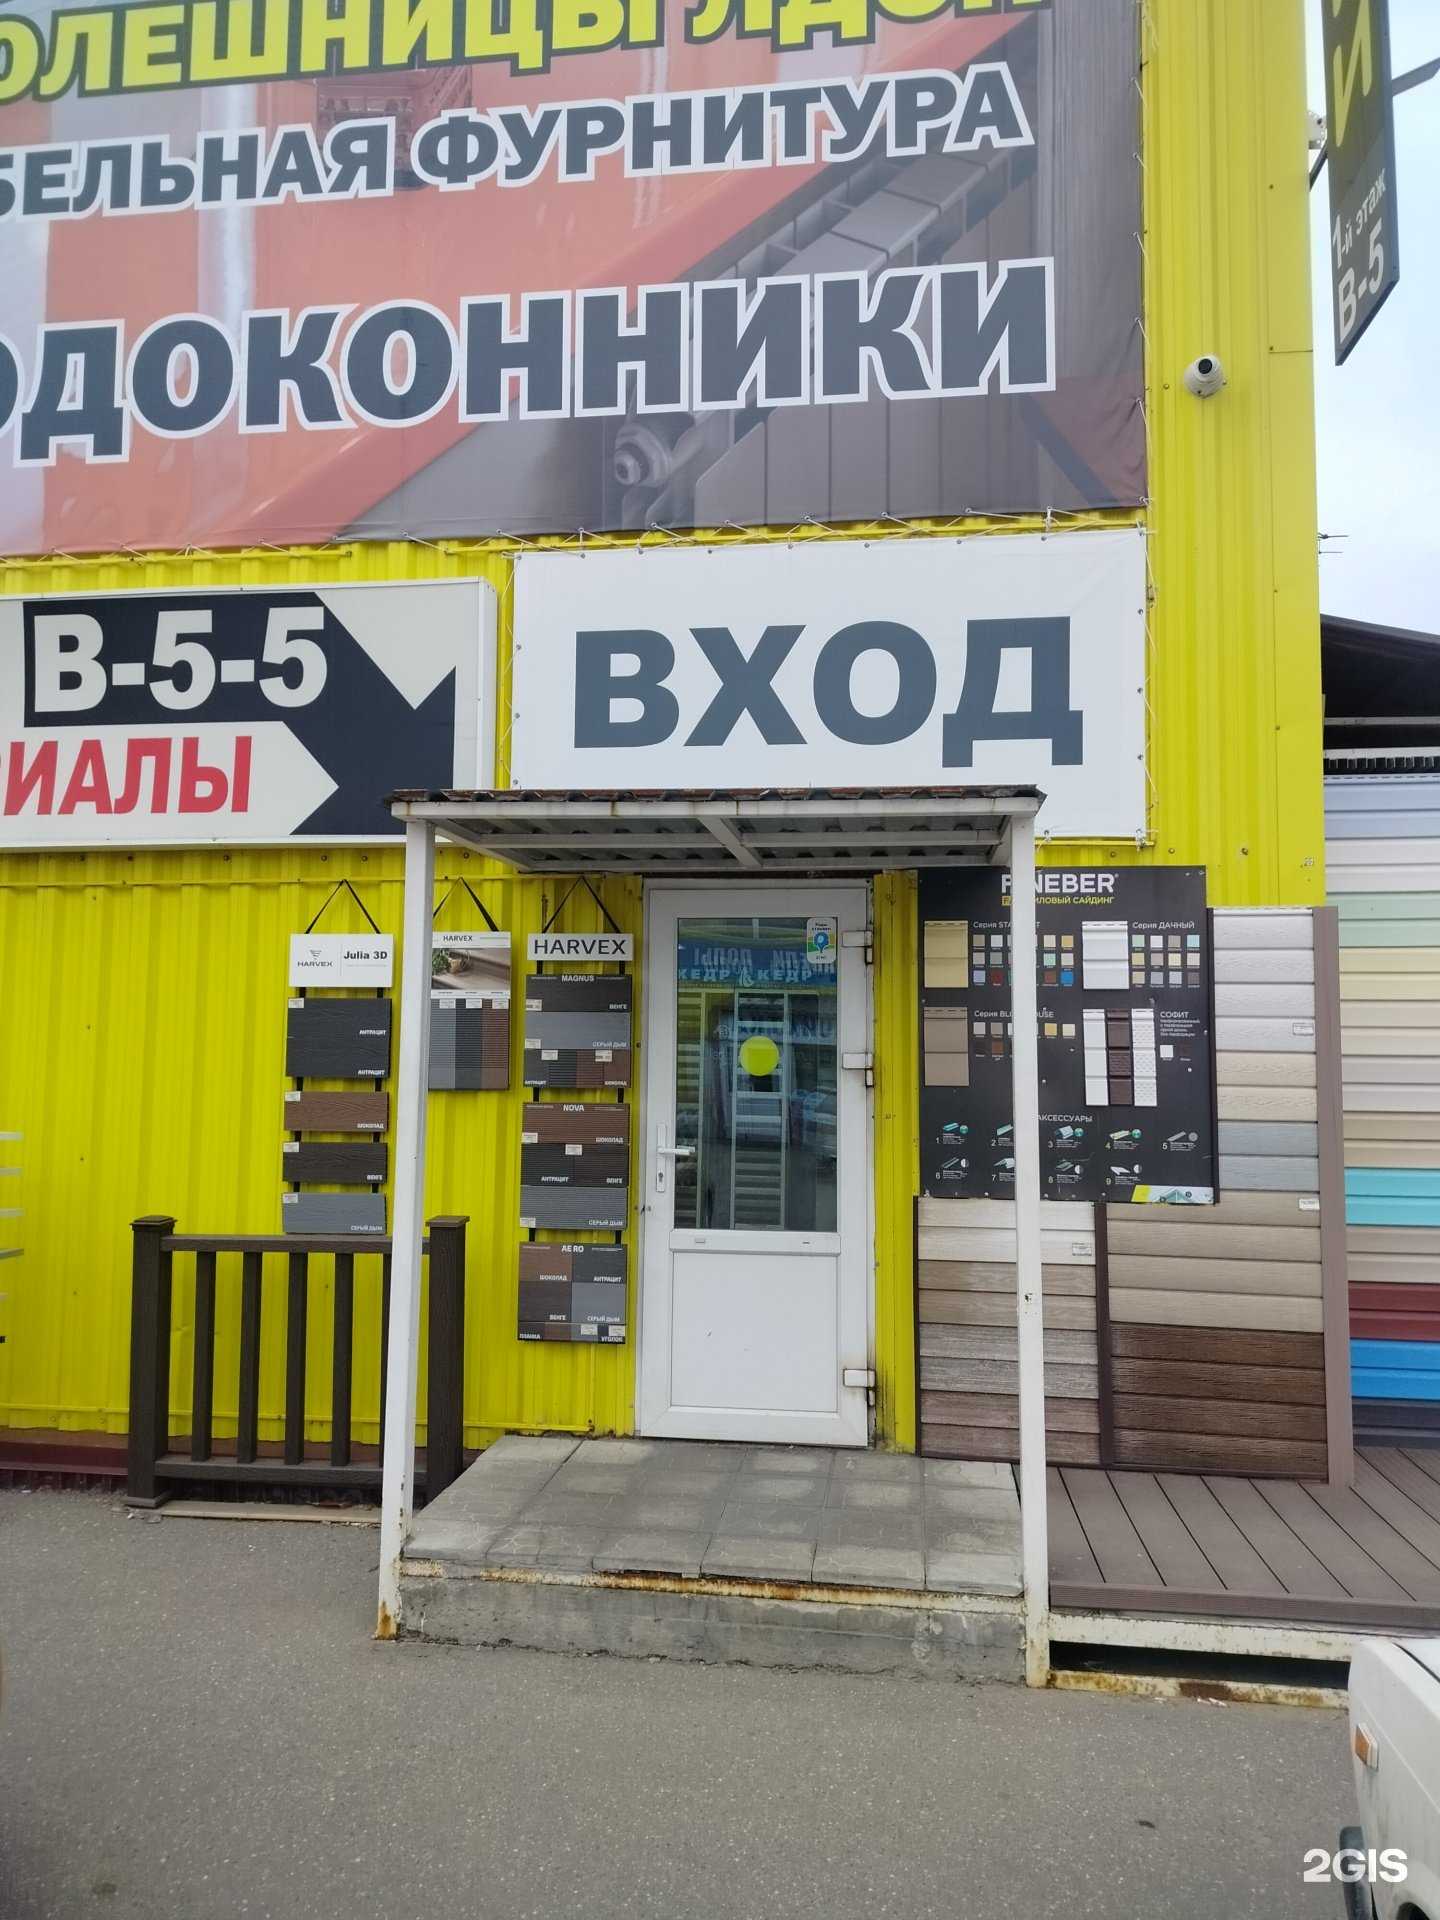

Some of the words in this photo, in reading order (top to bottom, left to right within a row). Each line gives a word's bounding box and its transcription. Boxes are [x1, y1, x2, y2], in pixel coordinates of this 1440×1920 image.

[414, 66, 1026, 185] ФУРНИТУРА
[1356, 169, 1386, 236] этаж
[1338, 217, 1384, 343] В-5
[0, 260, 1052, 462] ДОКОННИКИ
[34, 606, 328, 713] В-5-5
[574, 616, 1083, 768] ВХОД
[0, 736, 252, 816] ИАЛЫ
[1073, 896, 1115, 905] САЙДИНГ
[973, 921, 997, 929] Серия
[1132, 921, 1157, 930] Серия
[1159, 920, 1195, 930] ДАЧНЫЙ
[344, 950, 370, 960] Julia
[373, 950, 388, 960] 3D
[533, 939, 626, 955] HARVEX
[561, 974, 595, 982] MAGNUS
[974, 1010, 998, 1018] Серия
[563, 1104, 585, 1112] NOVA
